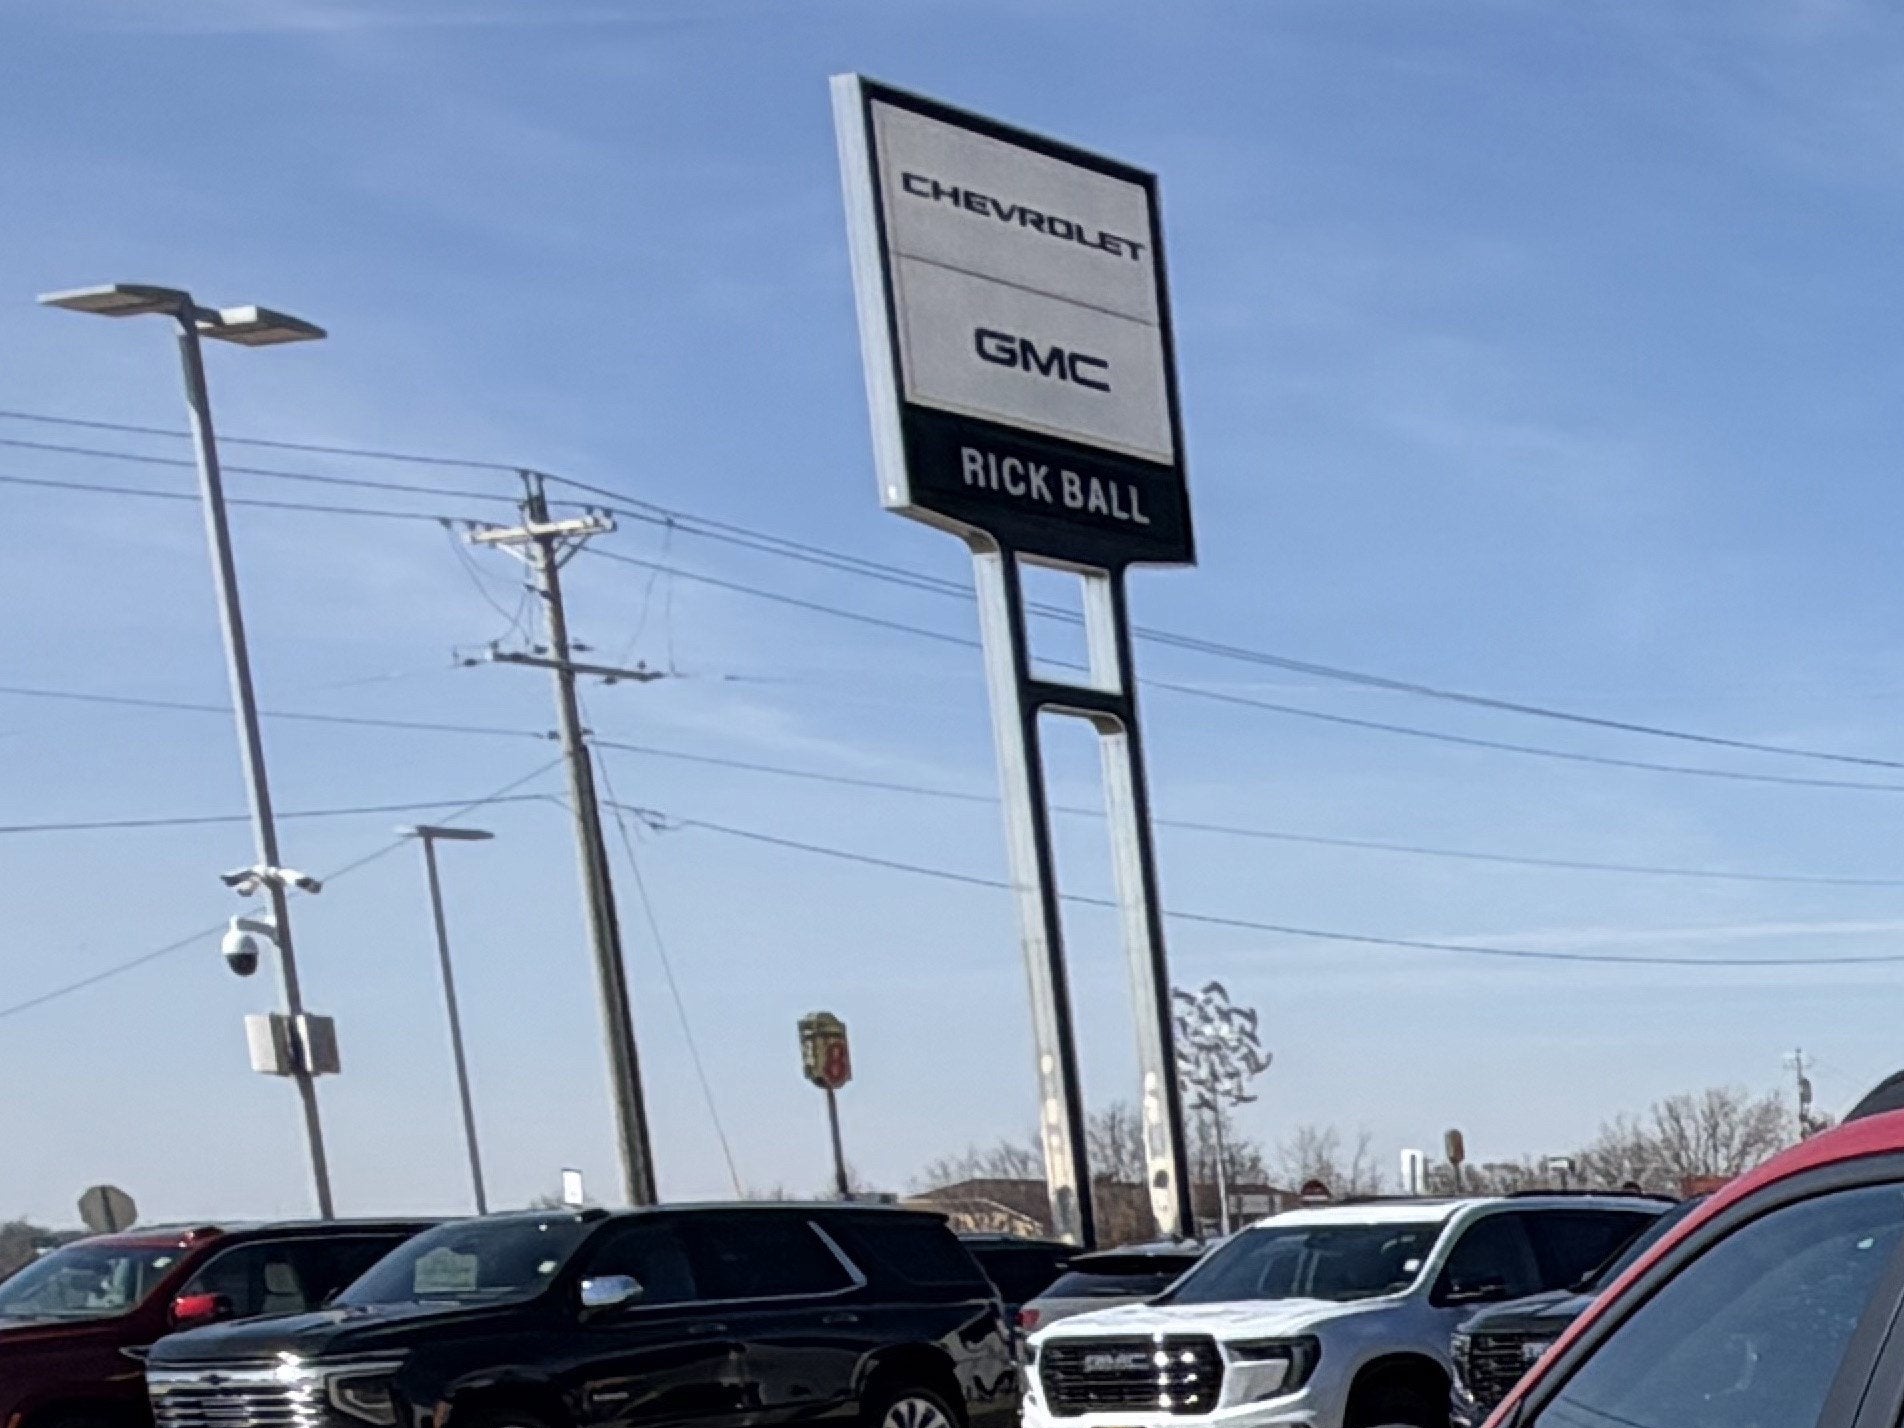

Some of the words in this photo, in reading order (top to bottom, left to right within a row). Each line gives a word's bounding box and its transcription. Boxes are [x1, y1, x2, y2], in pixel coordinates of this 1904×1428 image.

[901, 171, 1146, 262] CHEVROLET
[974, 327, 1111, 393] GMC
[961, 446, 1052, 505] RICK
[1060, 469, 1150, 525] BALL
